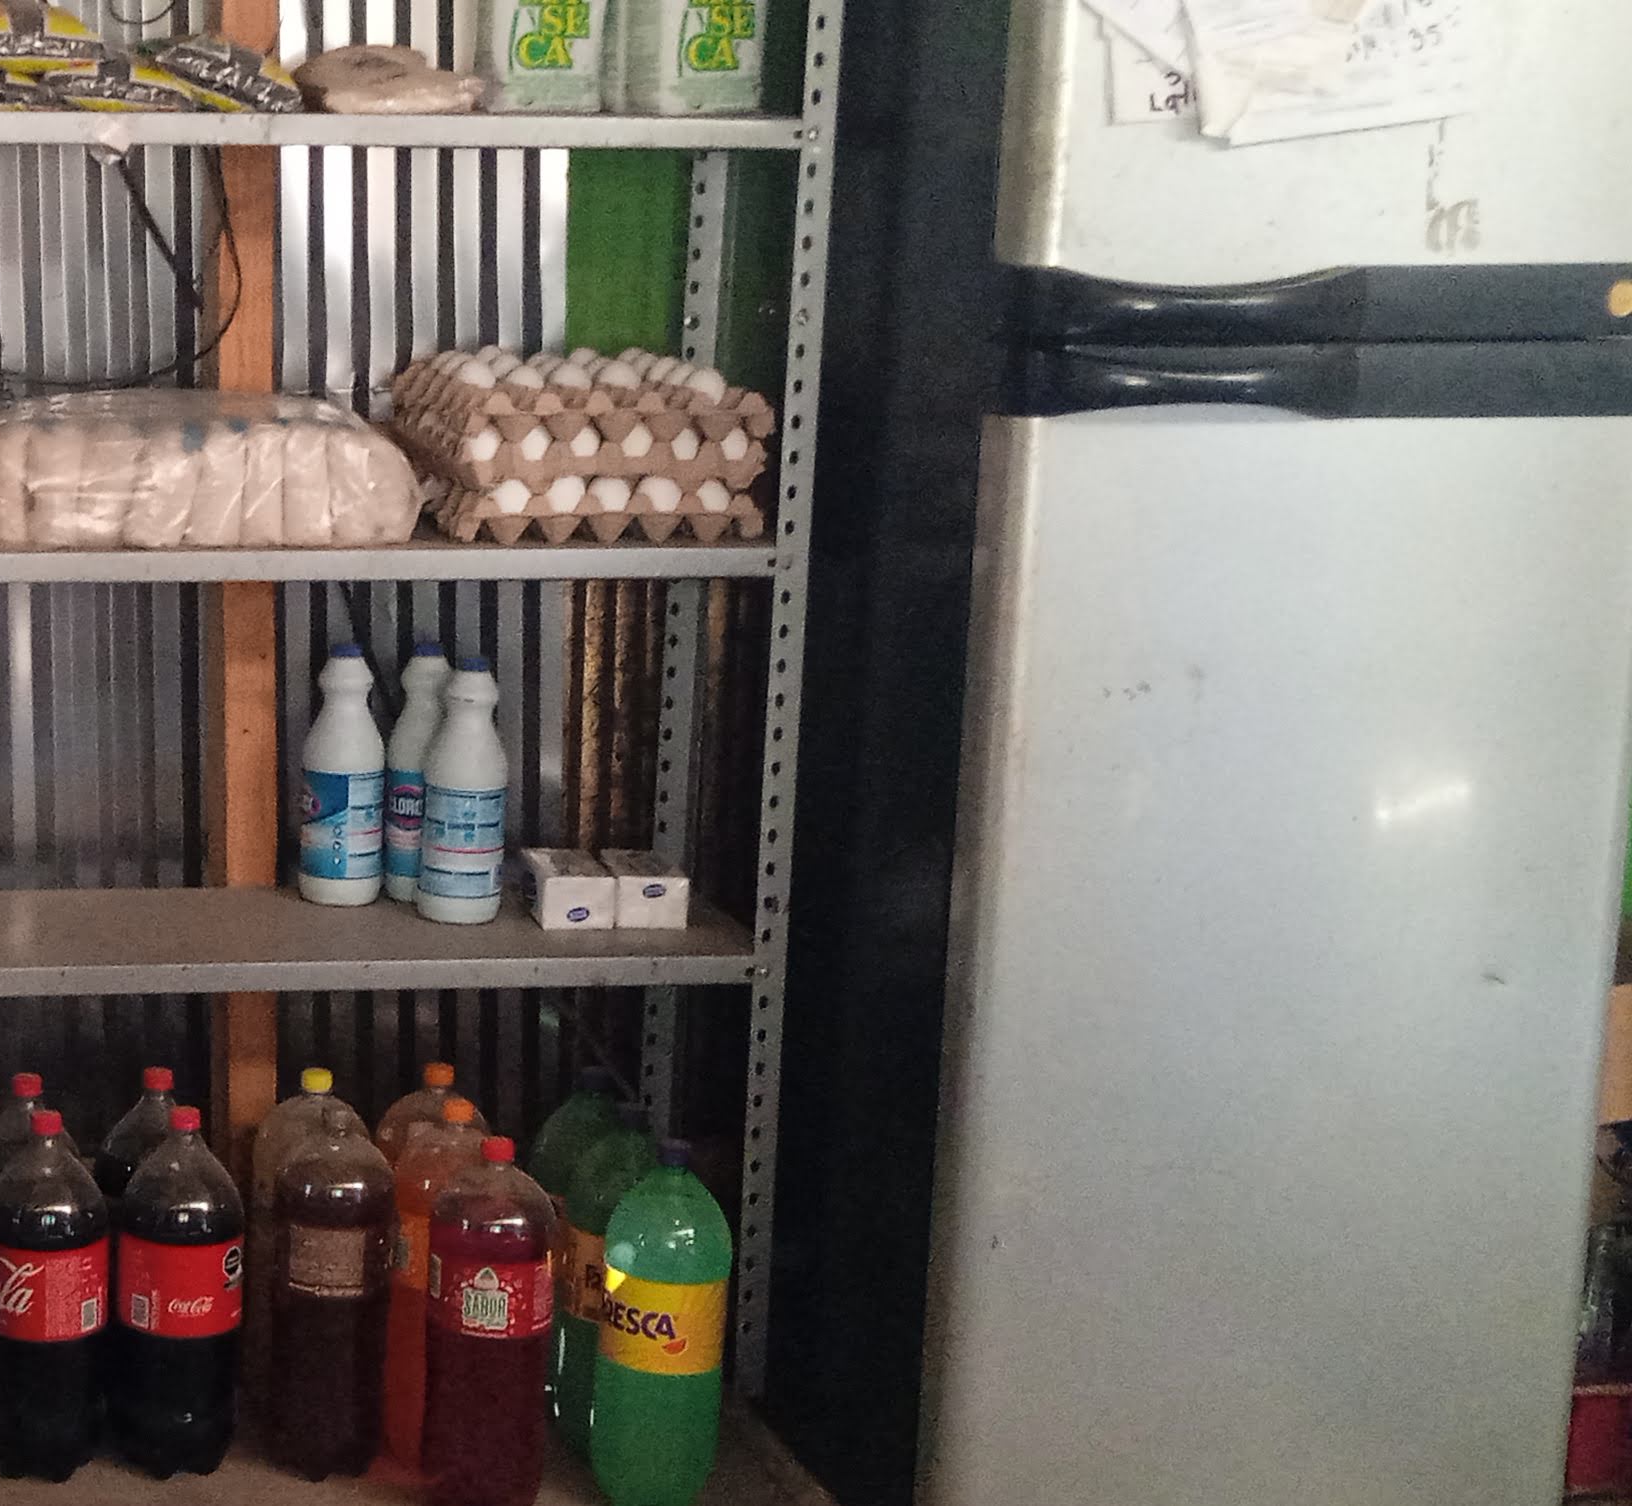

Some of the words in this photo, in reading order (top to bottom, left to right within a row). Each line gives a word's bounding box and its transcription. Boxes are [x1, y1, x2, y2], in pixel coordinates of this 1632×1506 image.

[518, 34, 571, 68] CA
[687, 35, 739, 70] CA
[390, 796, 424, 816] CLORO
[602, 1291, 676, 1341] RESCA
